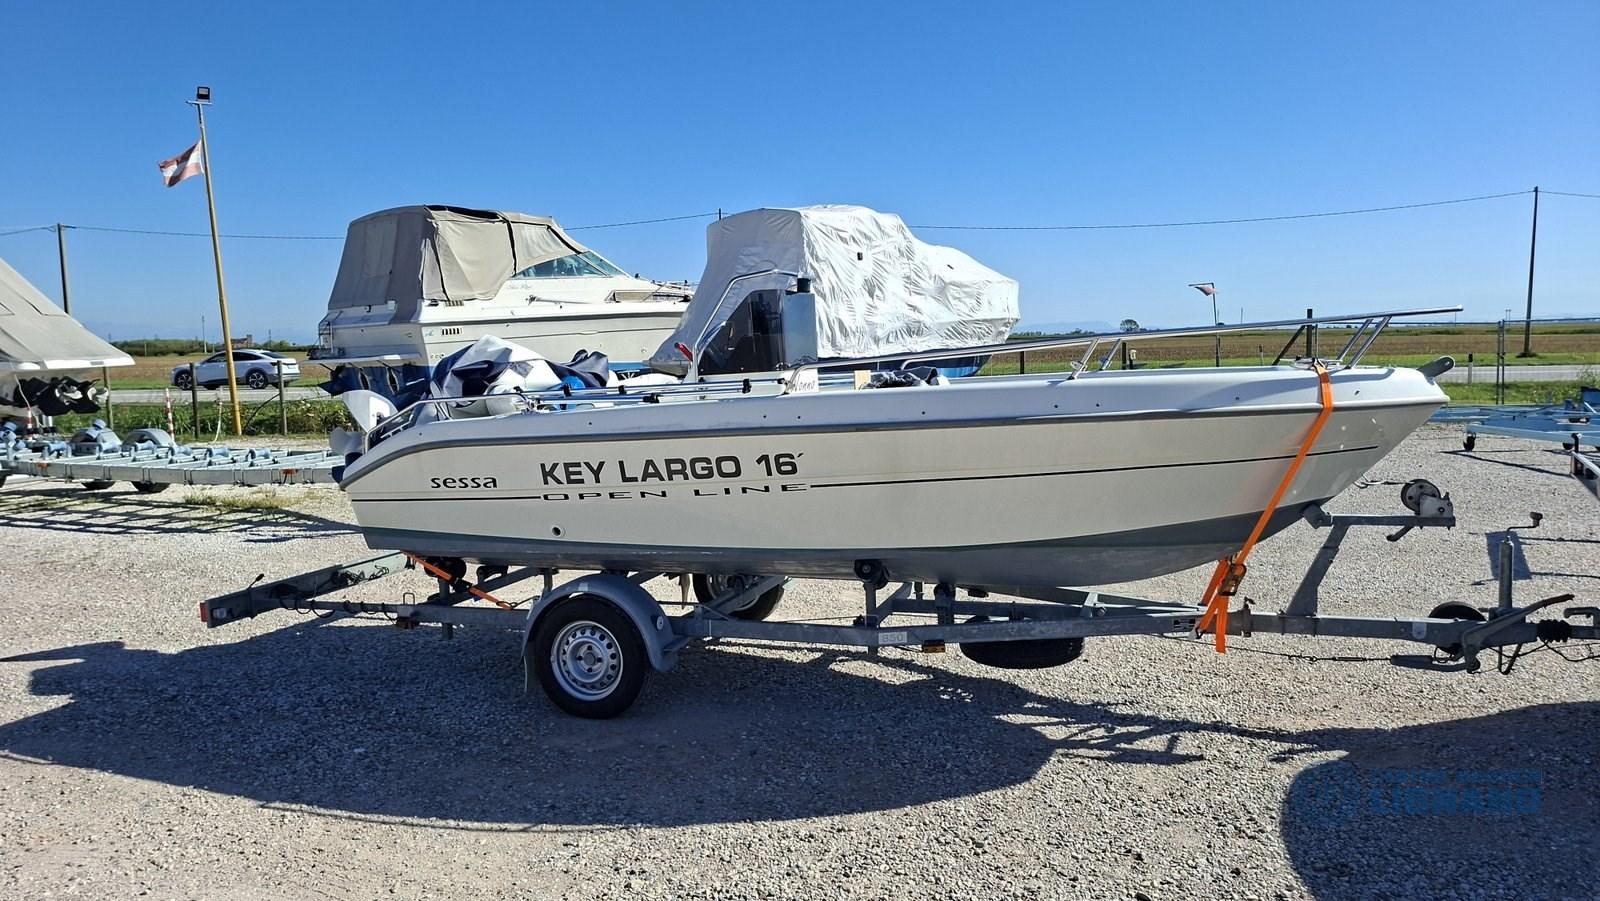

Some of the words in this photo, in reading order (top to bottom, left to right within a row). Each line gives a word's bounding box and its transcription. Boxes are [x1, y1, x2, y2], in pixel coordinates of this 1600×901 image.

[540, 461, 605, 486] KEY
[617, 455, 742, 483] LARGO
[430, 476, 498, 489] sessa
[542, 490, 668, 501] OPEN
[693, 483, 807, 497] LINE
